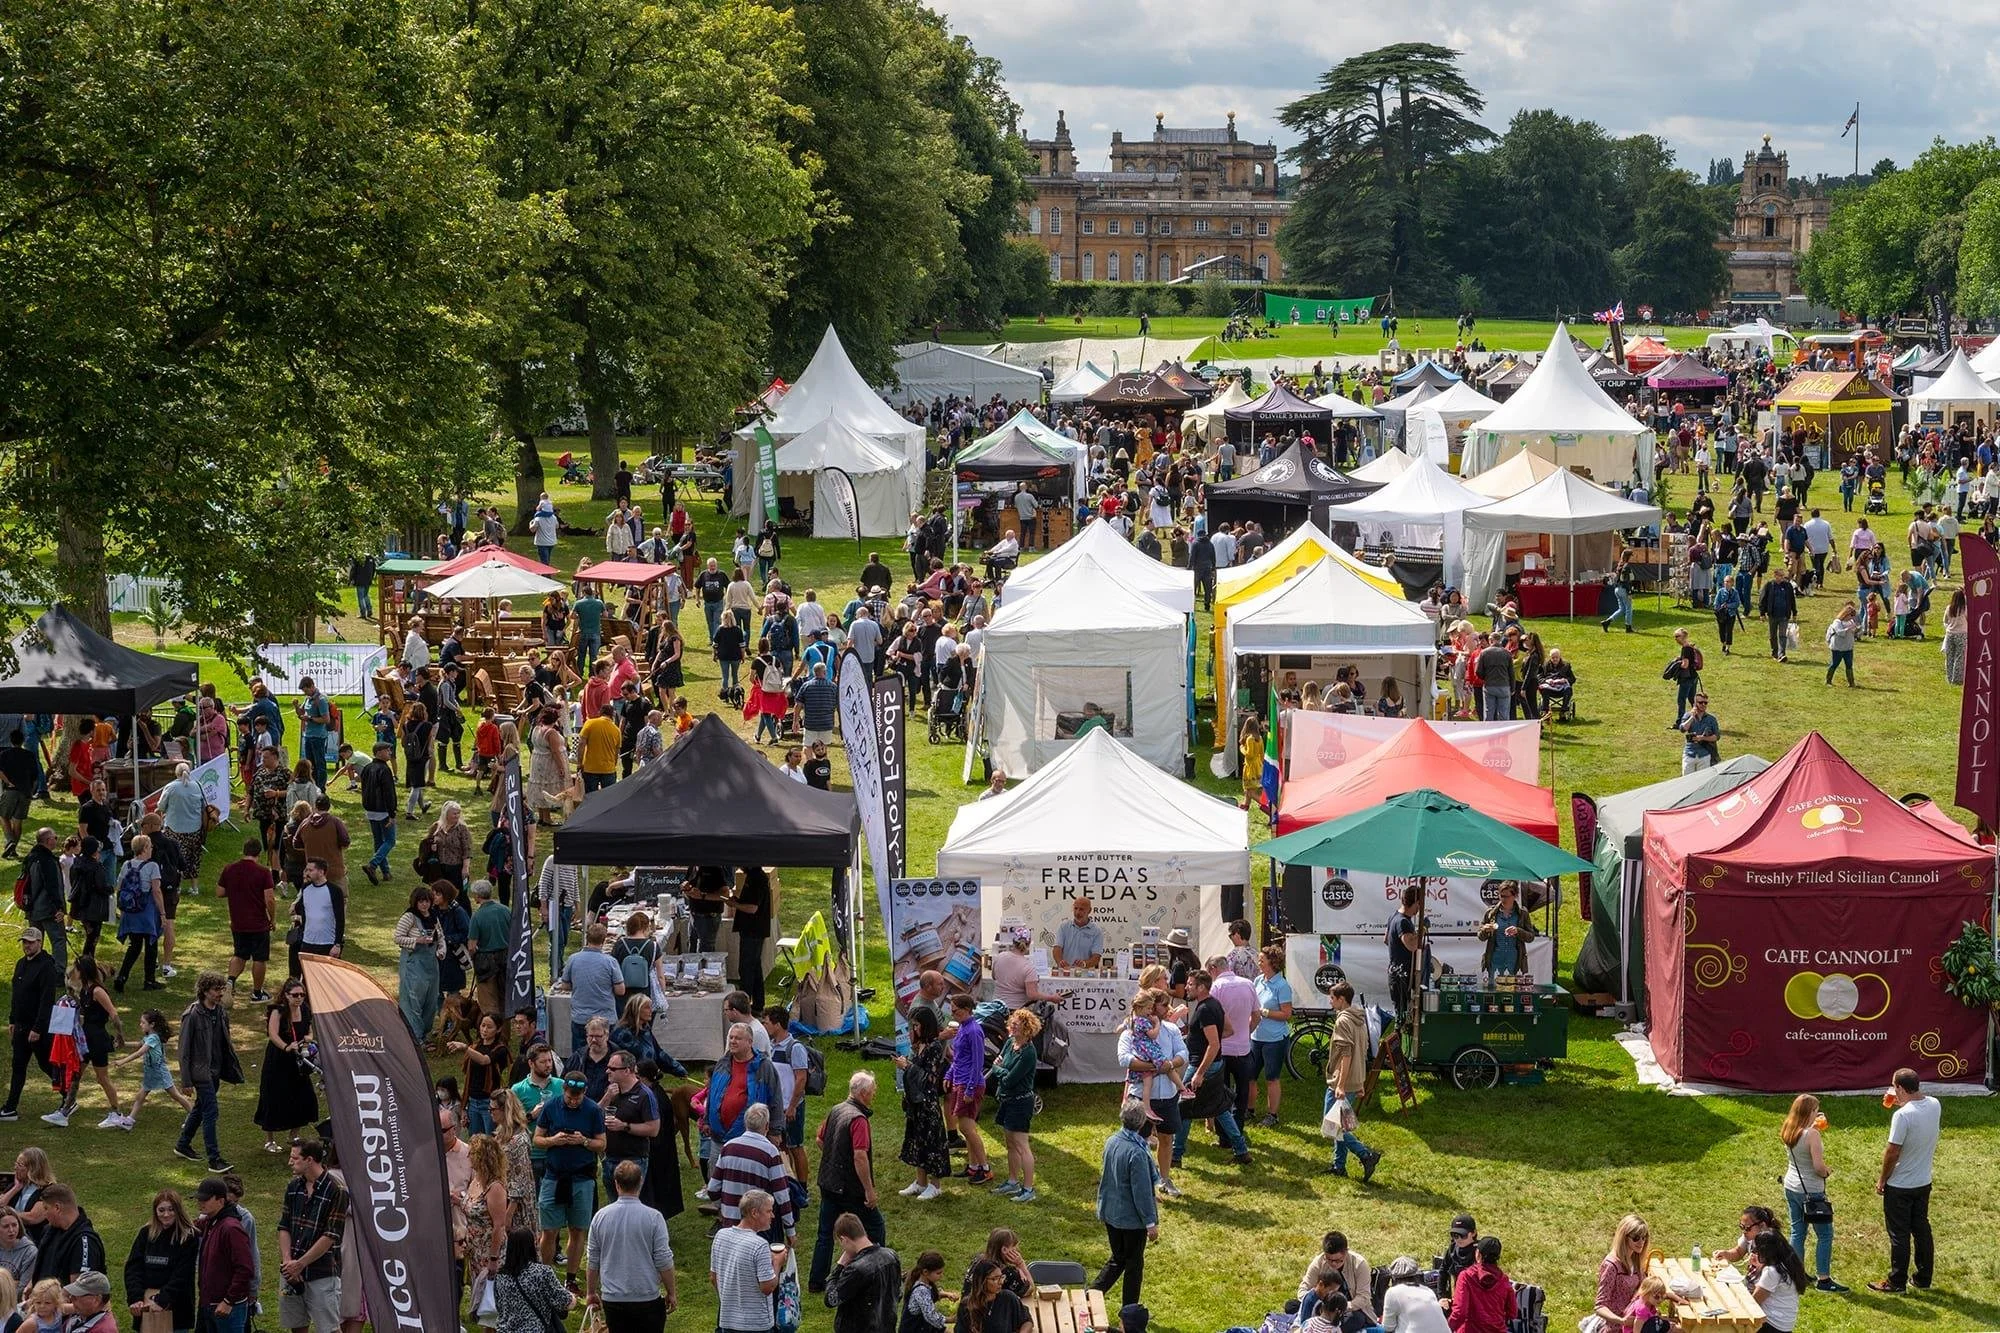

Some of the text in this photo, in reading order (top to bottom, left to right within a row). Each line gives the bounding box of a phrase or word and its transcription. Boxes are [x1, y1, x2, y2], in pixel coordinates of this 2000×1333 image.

[1259, 412, 1321, 420] OLIVIER'S BAKERY
[1838, 420, 1881, 452] Wicked
[1971, 611, 1994, 795] CANNOLI
[1785, 800, 1814, 815] CAFE
[1056, 854, 1133, 862] PEANUT BUTTER
[1041, 866, 1148, 884] FREDA'S
[1746, 869, 1940, 888] Freshly Filled Sicilian Cannoli
[1044, 885, 1158, 901] FREDA'S
[1323, 890, 1353, 900] taste
[1481, 891, 1500, 900] tas
[1093, 906, 1115, 915] ROM
[1764, 948, 1810, 964] CAFE
[1316, 975, 1346, 985] taste
[1057, 997, 1127, 1011] REDA'S
[1482, 1033, 1508, 1041] BARRIES
[1785, 1027, 1888, 1041] cafe-cannoli.com
